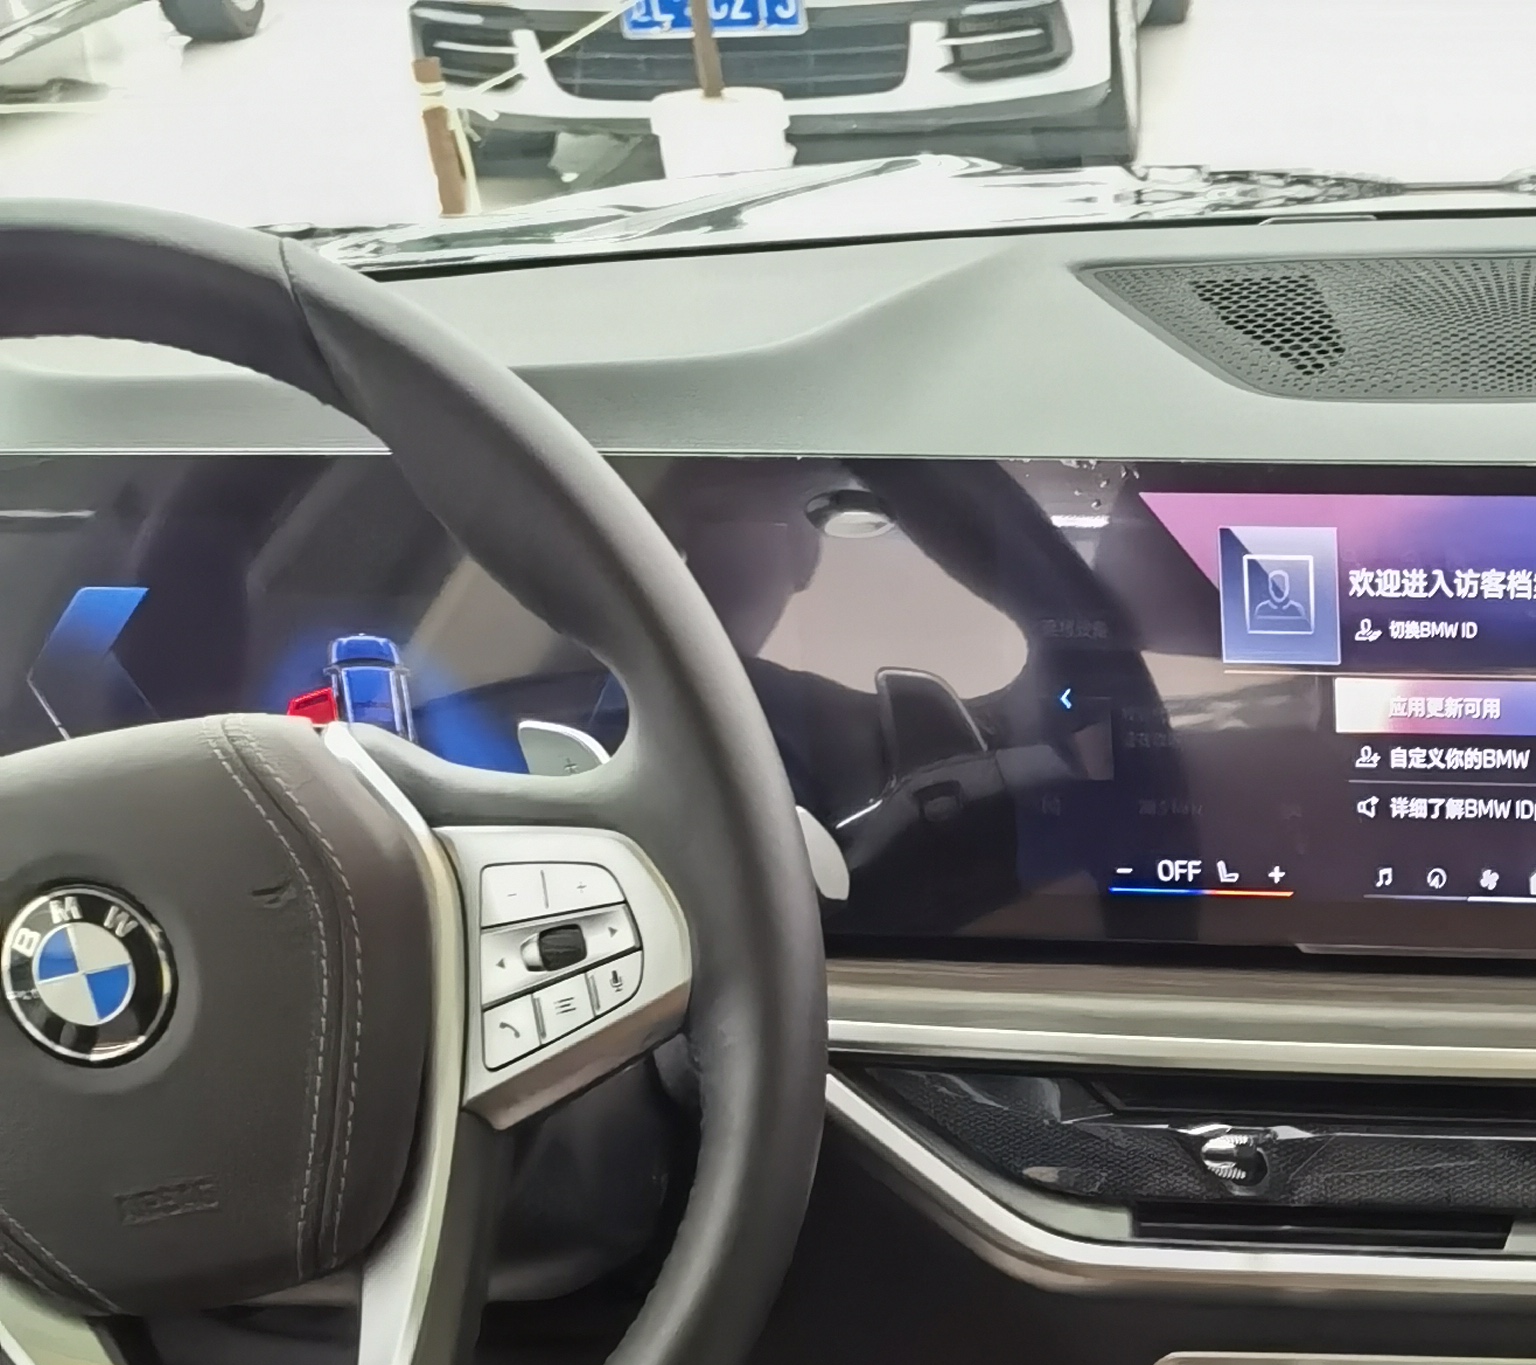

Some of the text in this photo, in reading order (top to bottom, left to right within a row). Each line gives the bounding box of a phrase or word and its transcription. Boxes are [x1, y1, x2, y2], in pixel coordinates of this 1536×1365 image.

[1388, 620, 1478, 640] 切换BMW ID
[1388, 695, 1501, 720] 应用更新可用
[1389, 747, 1531, 770] 自定义你的BMW
[1389, 796, 1512, 820] 详细了解BMW
[1157, 859, 1202, 882] OFF
[11, 896, 139, 958] BMW
